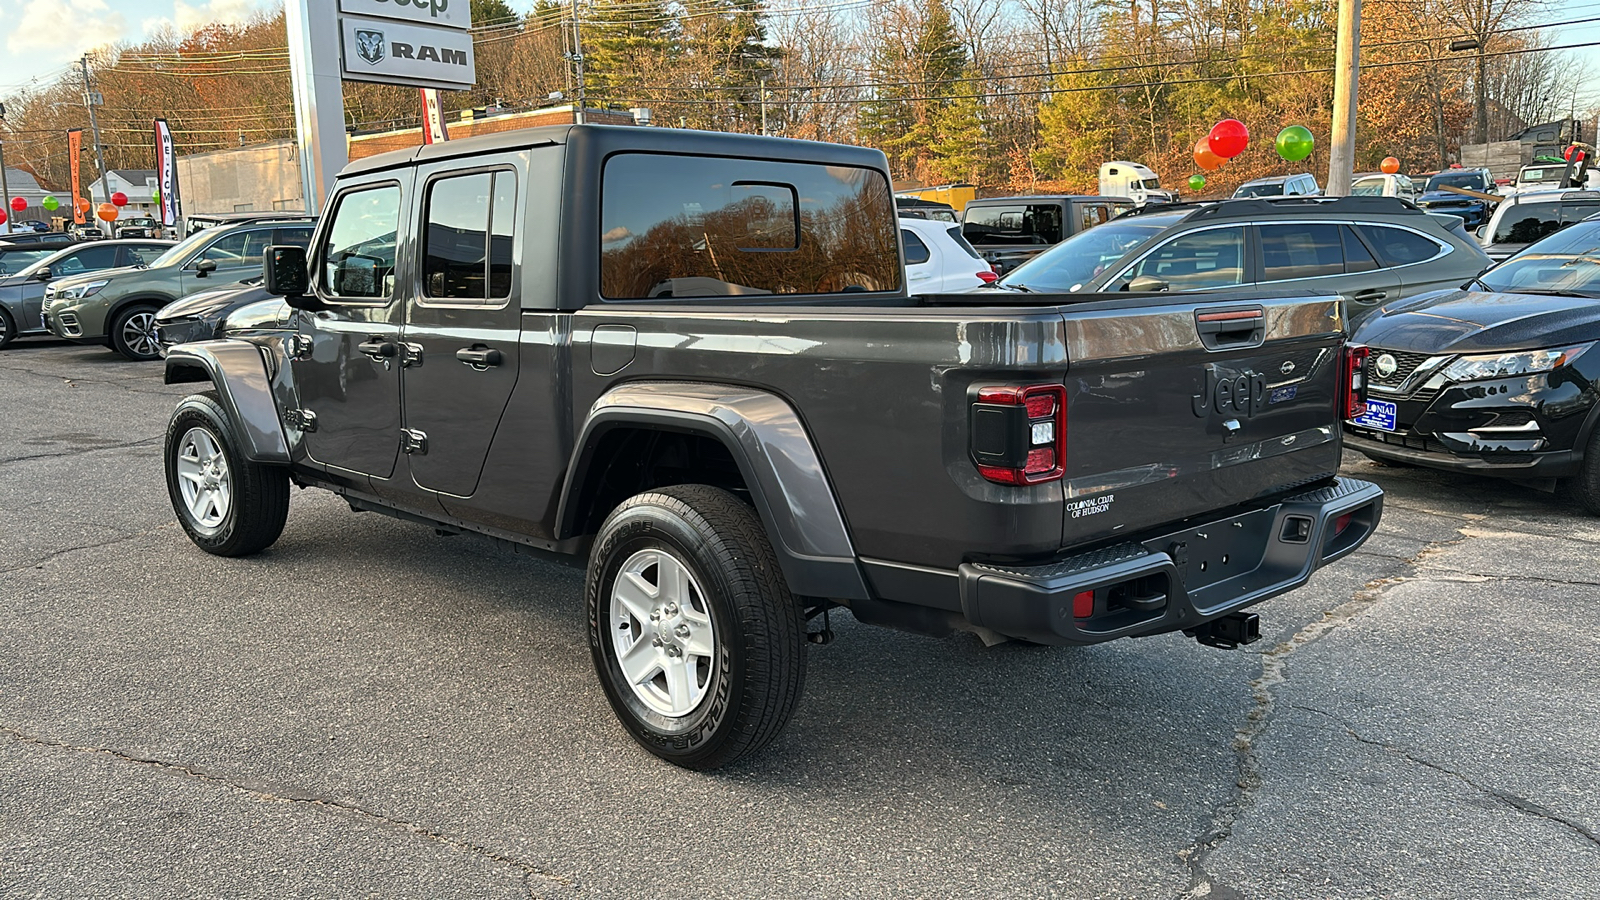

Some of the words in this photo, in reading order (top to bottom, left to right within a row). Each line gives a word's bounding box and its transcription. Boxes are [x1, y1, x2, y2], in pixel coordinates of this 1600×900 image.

[375, 0, 448, 17] ep
[391, 42, 468, 66] RAM
[1191, 368, 1266, 418] Jeep
[1366, 402, 1395, 416] LONIAL
[1066, 499, 1097, 511] COLONIAL
[1071, 509, 1081, 518] OF
[1082, 503, 1109, 516] HUDSON
[672, 642, 731, 750] DUELER
